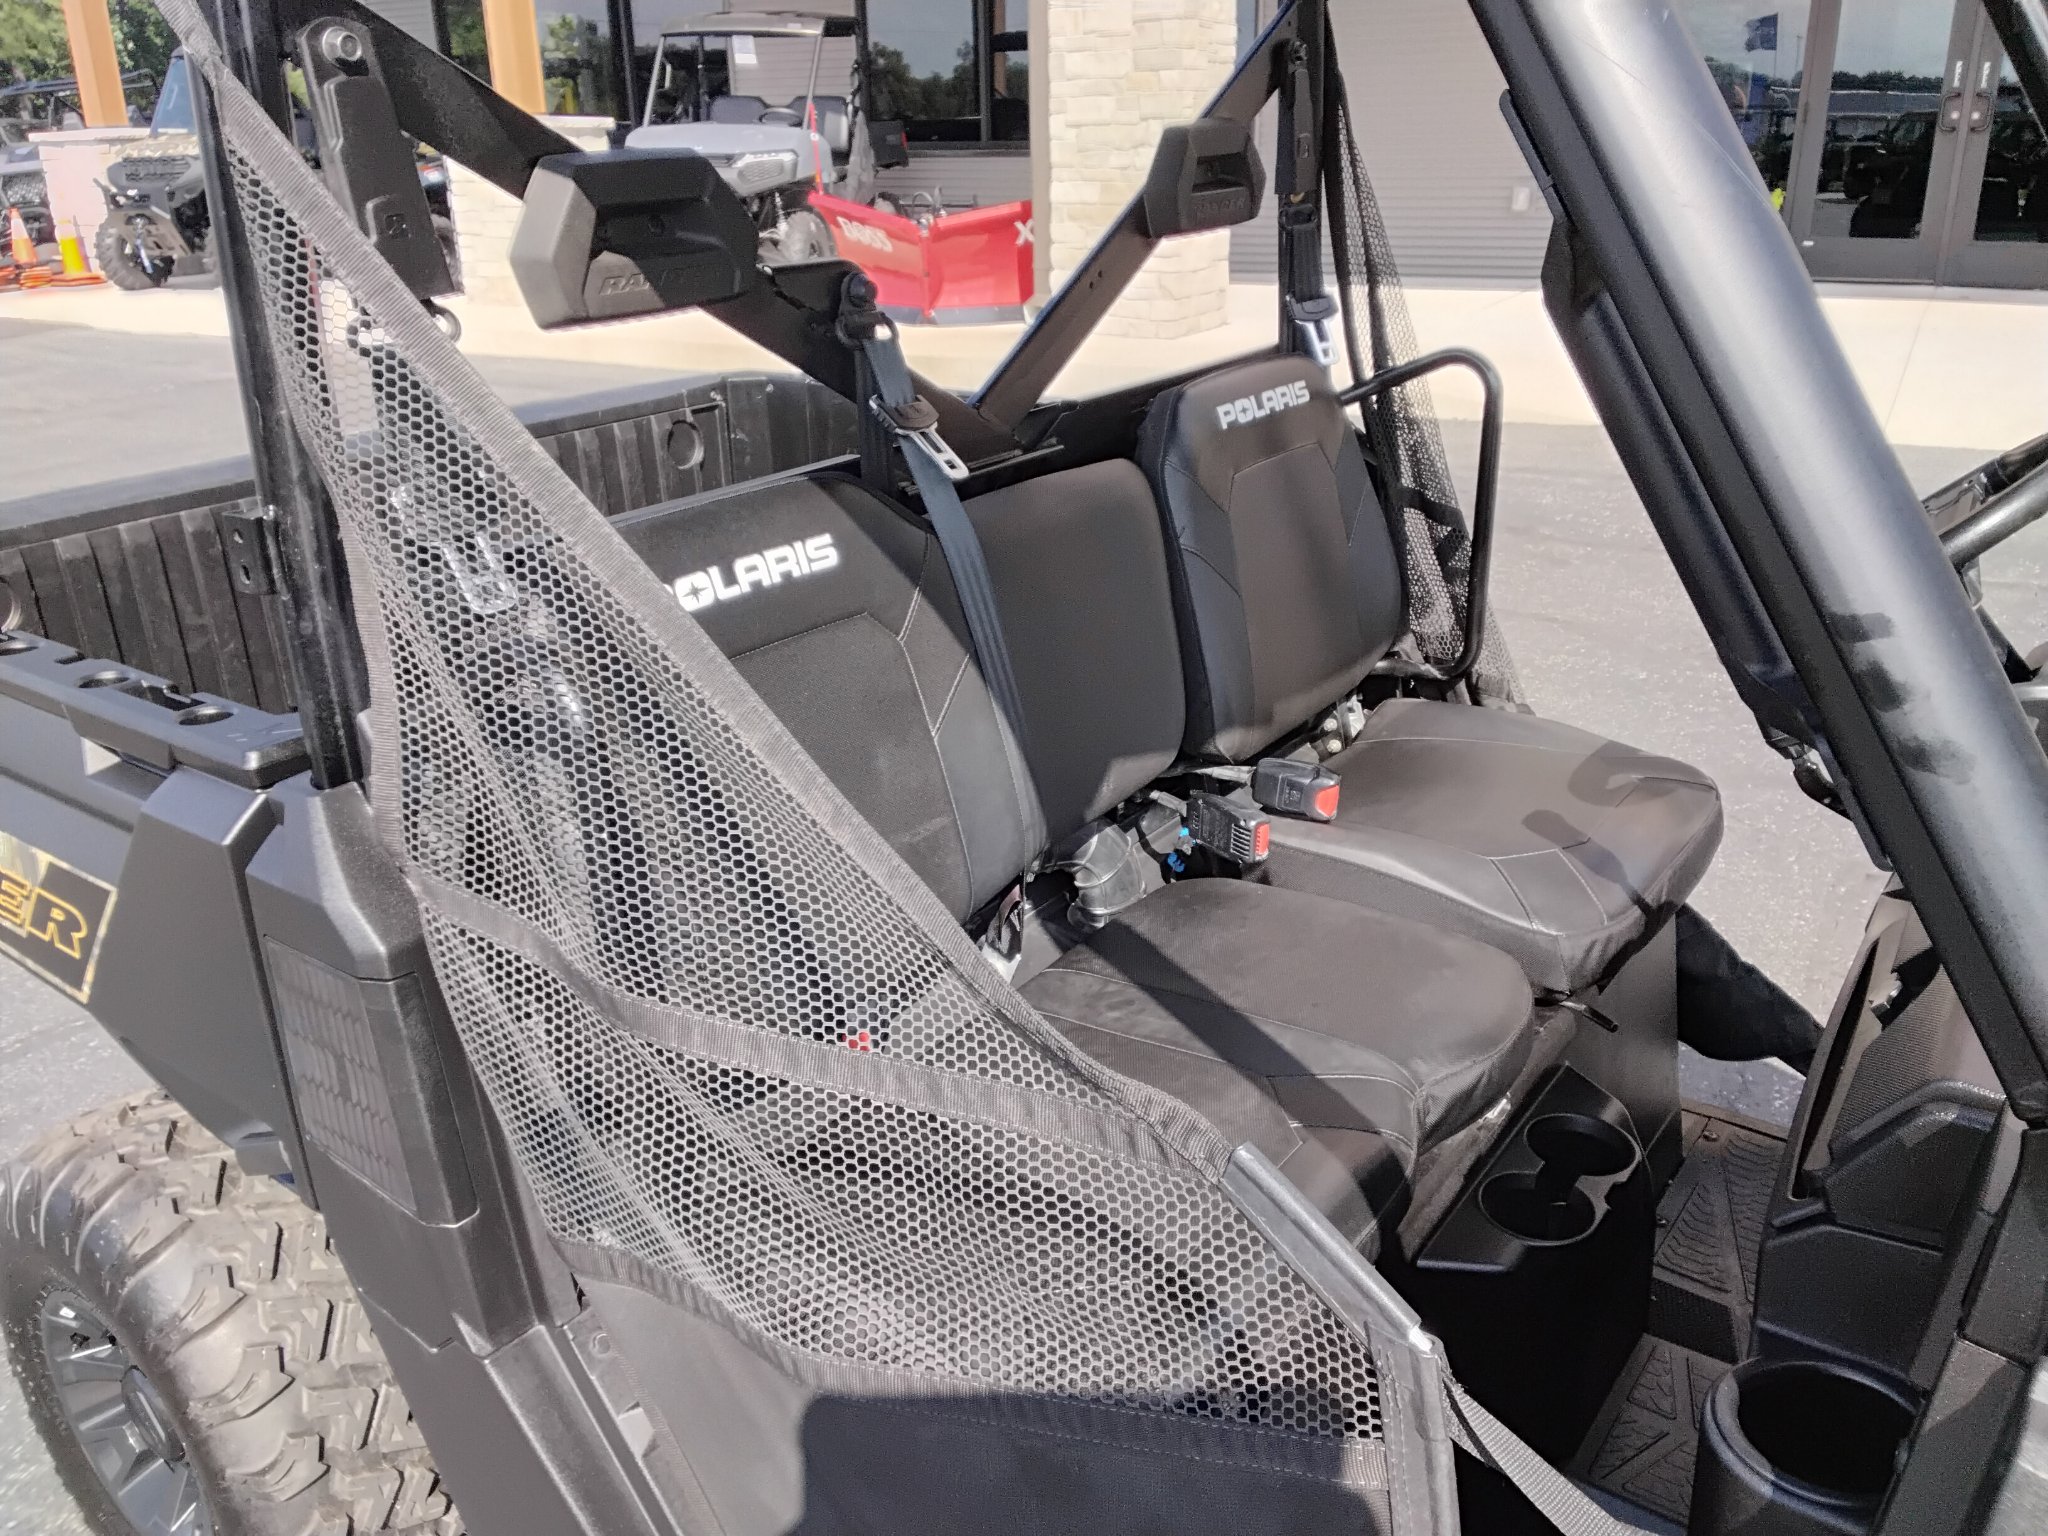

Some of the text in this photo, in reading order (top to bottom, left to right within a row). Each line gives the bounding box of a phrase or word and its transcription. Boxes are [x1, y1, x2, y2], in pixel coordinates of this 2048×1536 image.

[836, 215, 894, 252] BOSS
[1216, 379, 1311, 430] POLARIS
[662, 533, 839, 612] OLARIS
